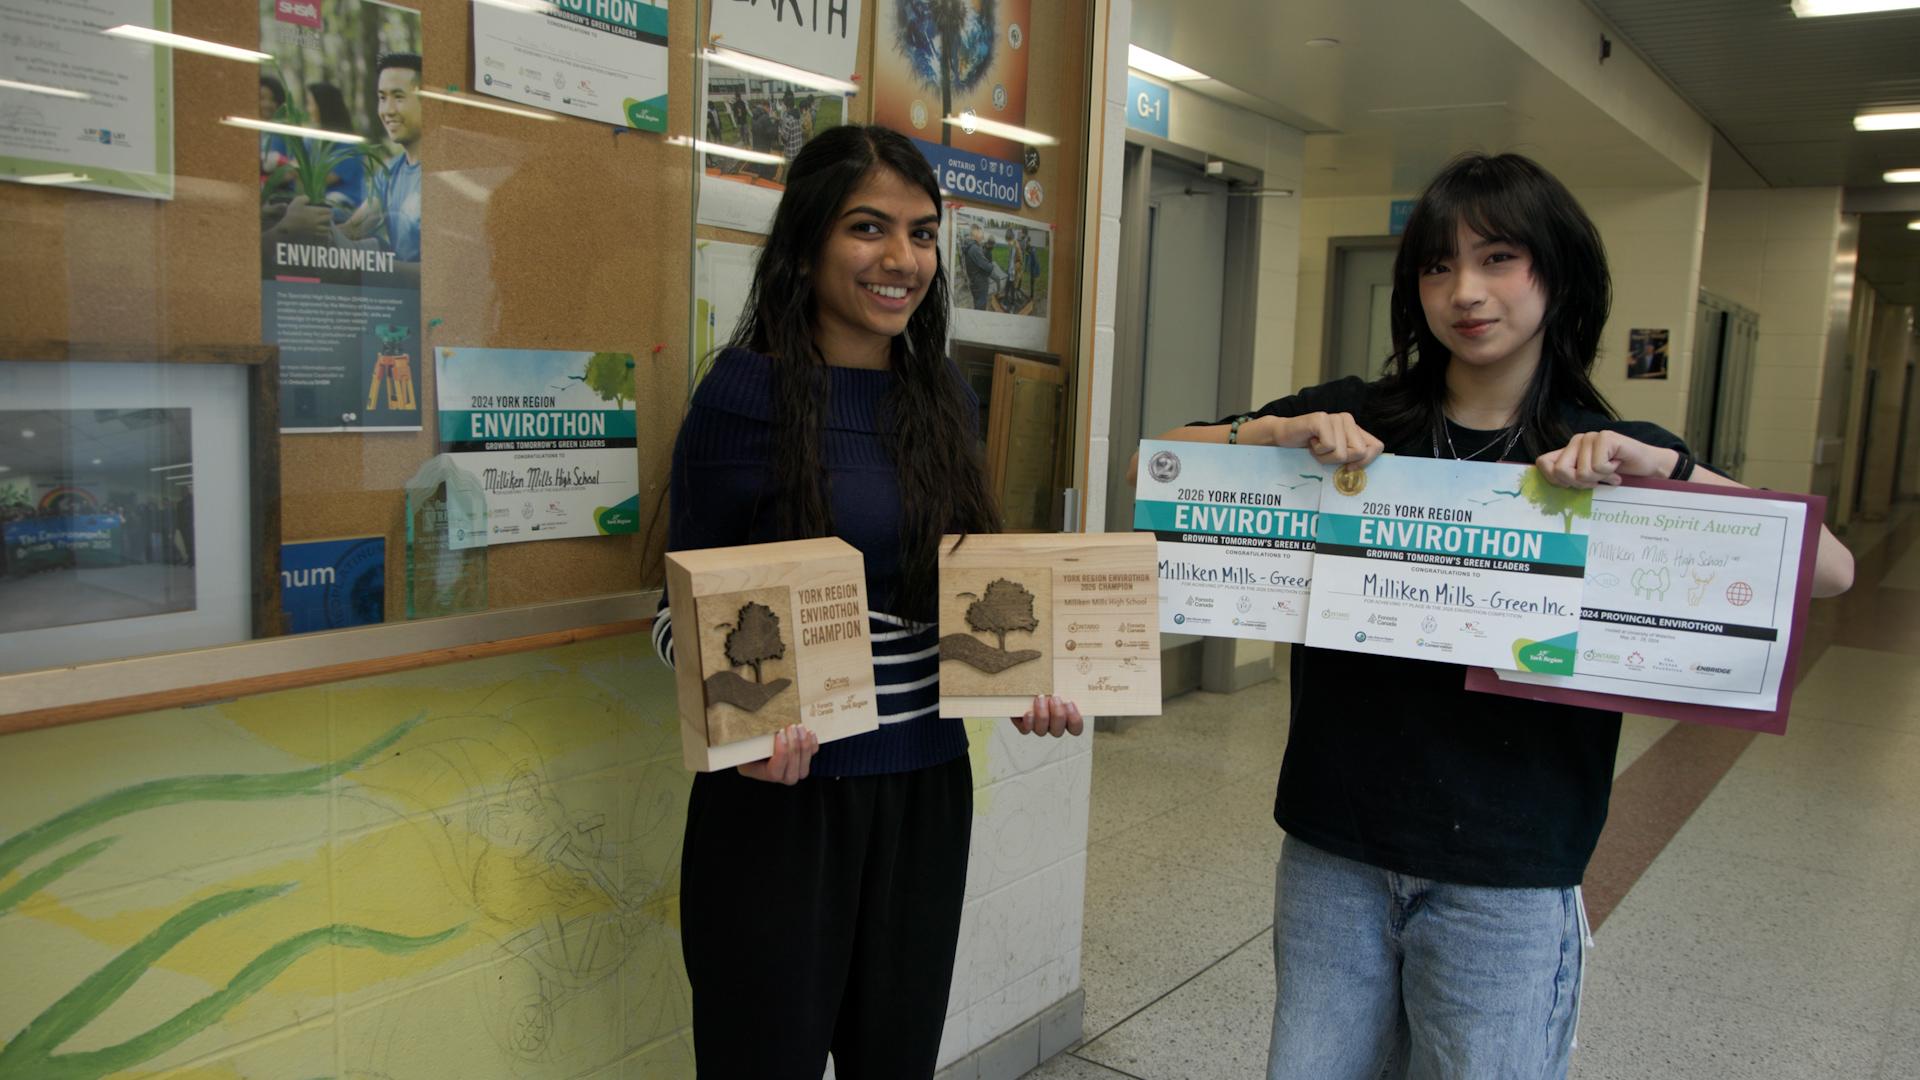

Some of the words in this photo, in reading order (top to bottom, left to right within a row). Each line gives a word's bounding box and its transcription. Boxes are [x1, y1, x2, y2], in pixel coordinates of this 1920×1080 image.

[590, 19, 611, 31] GREEN
[611, 25, 637, 39] LEADERS
[732, 0, 848, 38] RTH
[1137, 91, 1160, 121] G-1
[948, 159, 976, 172] ONTARIO
[276, 242, 396, 273] ENVIRONMENT
[471, 395, 493, 409] 2024
[496, 396, 520, 408] YORK
[523, 396, 556, 408] REGION
[471, 412, 605, 438] ENVIROTHON
[485, 441, 515, 451] GROWING
[516, 441, 557, 450] TOMORROW'S
[558, 440, 578, 449] GREEN
[579, 439, 606, 448] LEADERS
[483, 468, 524, 494] Milliken
[527, 467, 552, 490] Mills
[555, 468, 572, 488] High
[573, 466, 600, 486] School
[1178, 488, 1204, 501] 2026
[1208, 490, 1237, 504] YORK
[1240, 492, 1282, 506] REGION
[1175, 505, 1319, 538] ENVIROTHO
[1363, 502, 1391, 516] 2026
[1394, 504, 1425, 519] YORK
[1428, 507, 1473, 523] REGION
[1592, 508, 1650, 526] irothon
[1653, 514, 1700, 532] Spirit
[1702, 519, 1762, 537] Award
[1182, 533, 1218, 544] GROWING
[1220, 536, 1272, 548] TOMORROW'S
[1274, 540, 1300, 550] GREEN
[1359, 519, 1542, 559] ENVIROTHON
[1225, 549, 1281, 559] CONGRATULATIONS
[1366, 549, 1404, 561] GROWING
[1406, 552, 1461, 566] TOMORROW'S
[1463, 557, 1491, 568] GREEN
[1493, 561, 1530, 572] LEADERS
[1641, 546, 1668, 565] Mills
[1063, 574, 1080, 582] YORK
[1081, 574, 1107, 582] REGION
[1108, 574, 1150, 582] ENVIROTHON
[1158, 559, 1218, 582] Milliken
[1222, 566, 1257, 585] Mills
[1411, 566, 1471, 577] CONGRATULATIONS
[798, 588, 823, 605] YORK
[825, 584, 858, 602] REGION
[1099, 583, 1133, 591] CHAMPION
[1363, 573, 1429, 603] Milliken
[1435, 582, 1475, 607] Mills
[1543, 596, 1574, 617] Inc.
[800, 601, 860, 624] ENVIROTHON
[1064, 598, 1091, 606] Milliken
[1109, 598, 1125, 607] High
[1600, 611, 1657, 626] PROVINCIAL
[1659, 618, 1724, 633] ENVIROTHON
[802, 620, 861, 647] CHAMPION
[1696, 664, 1732, 675] ENBRIDGE
